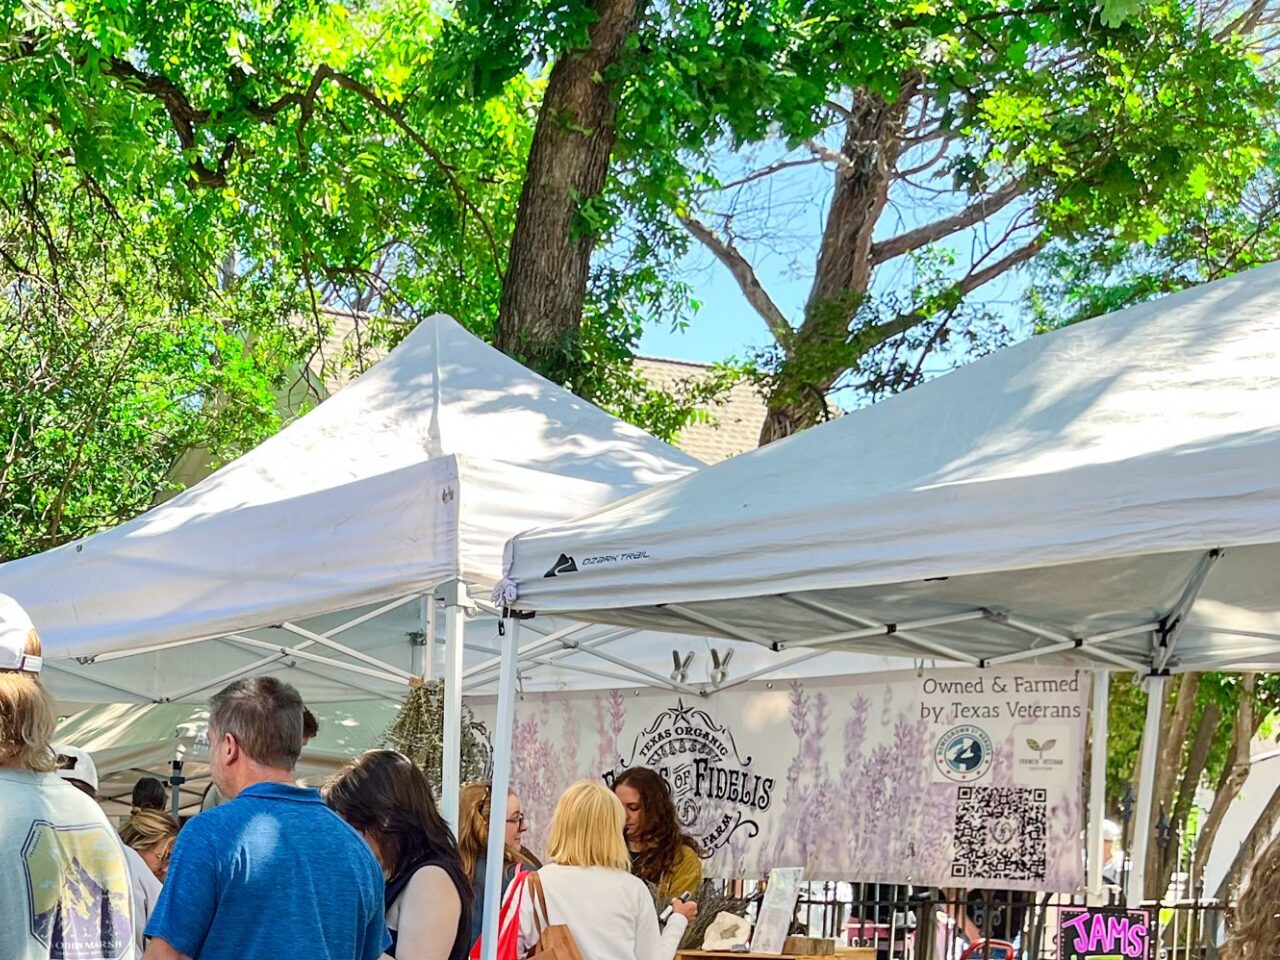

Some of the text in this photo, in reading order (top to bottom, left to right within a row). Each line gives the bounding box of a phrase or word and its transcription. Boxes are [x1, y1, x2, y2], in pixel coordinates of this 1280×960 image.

[923, 674, 1079, 694] Owned & Farmed
[920, 702, 1081, 723] by Texas Veterans
[639, 727, 729, 757] TEXAS ORGANIC
[674, 771, 690, 789] OF
[693, 758, 774, 810] FIDELIS
[702, 813, 733, 848] FARM
[1061, 912, 1147, 958] JAMS
